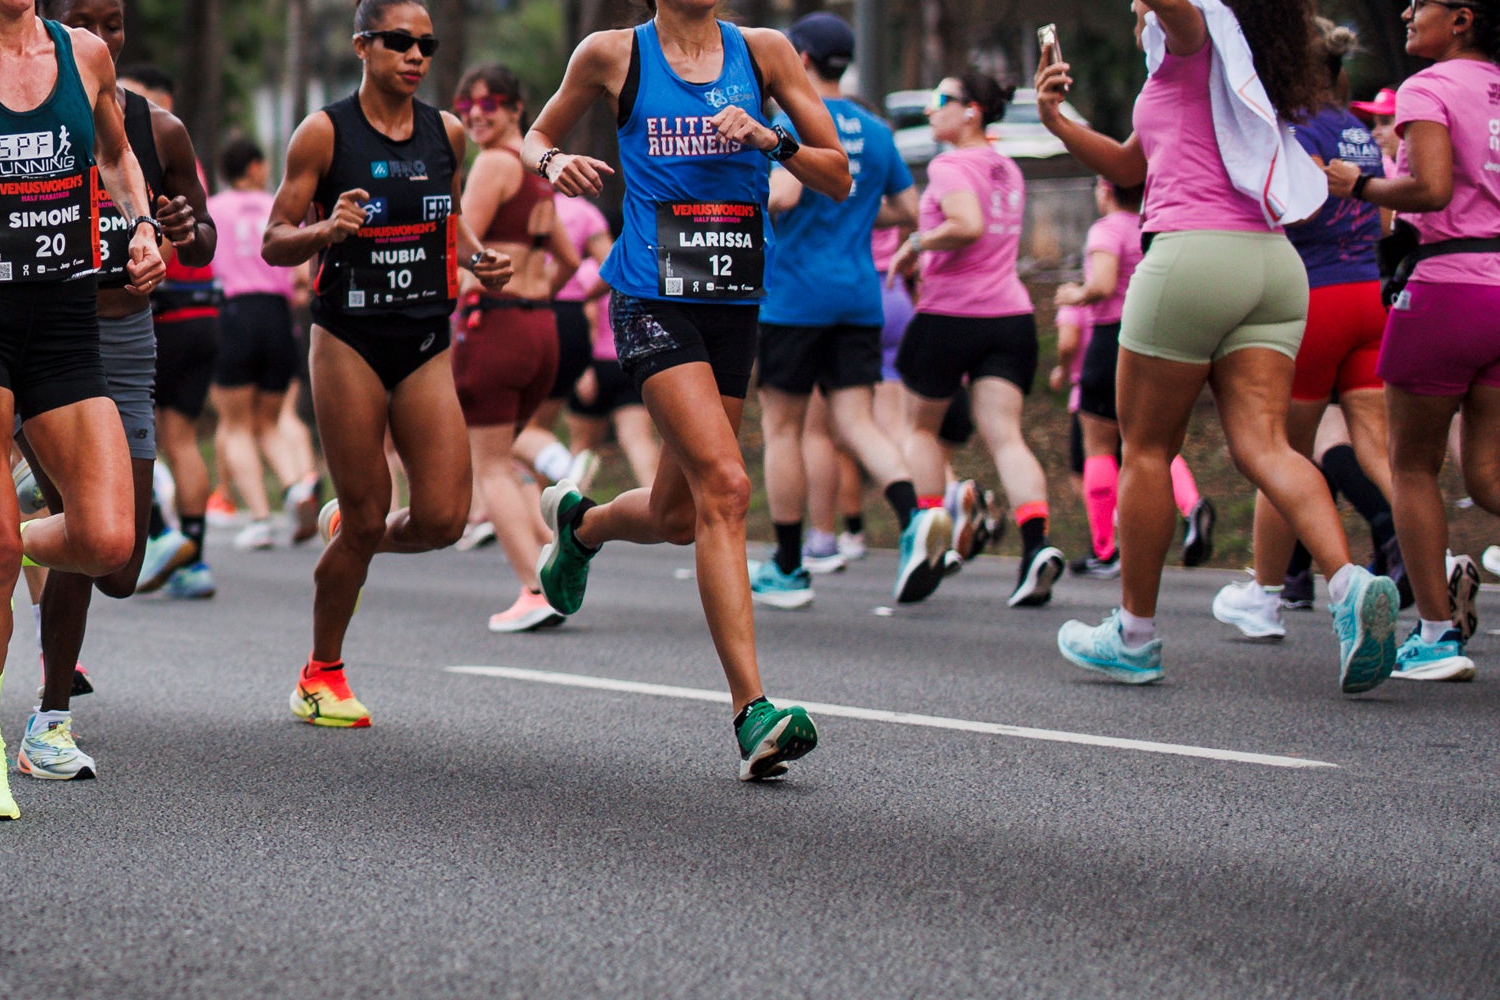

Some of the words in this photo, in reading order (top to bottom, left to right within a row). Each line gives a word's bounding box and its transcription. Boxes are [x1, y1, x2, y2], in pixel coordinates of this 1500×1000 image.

[647, 116, 714, 135] ELITE
[0, 174, 83, 195] VENUSWOMEN'S
[39, 191, 70, 201] MARATHON
[8, 204, 81, 229] SIMONE
[672, 204, 755, 217] VENUSWOMEN'S
[35, 233, 66, 258] 20
[679, 231, 753, 249] LARISSA
[371, 248, 426, 264] NUBIA
[708, 254, 733, 277] 12
[387, 269, 412, 289] 10
